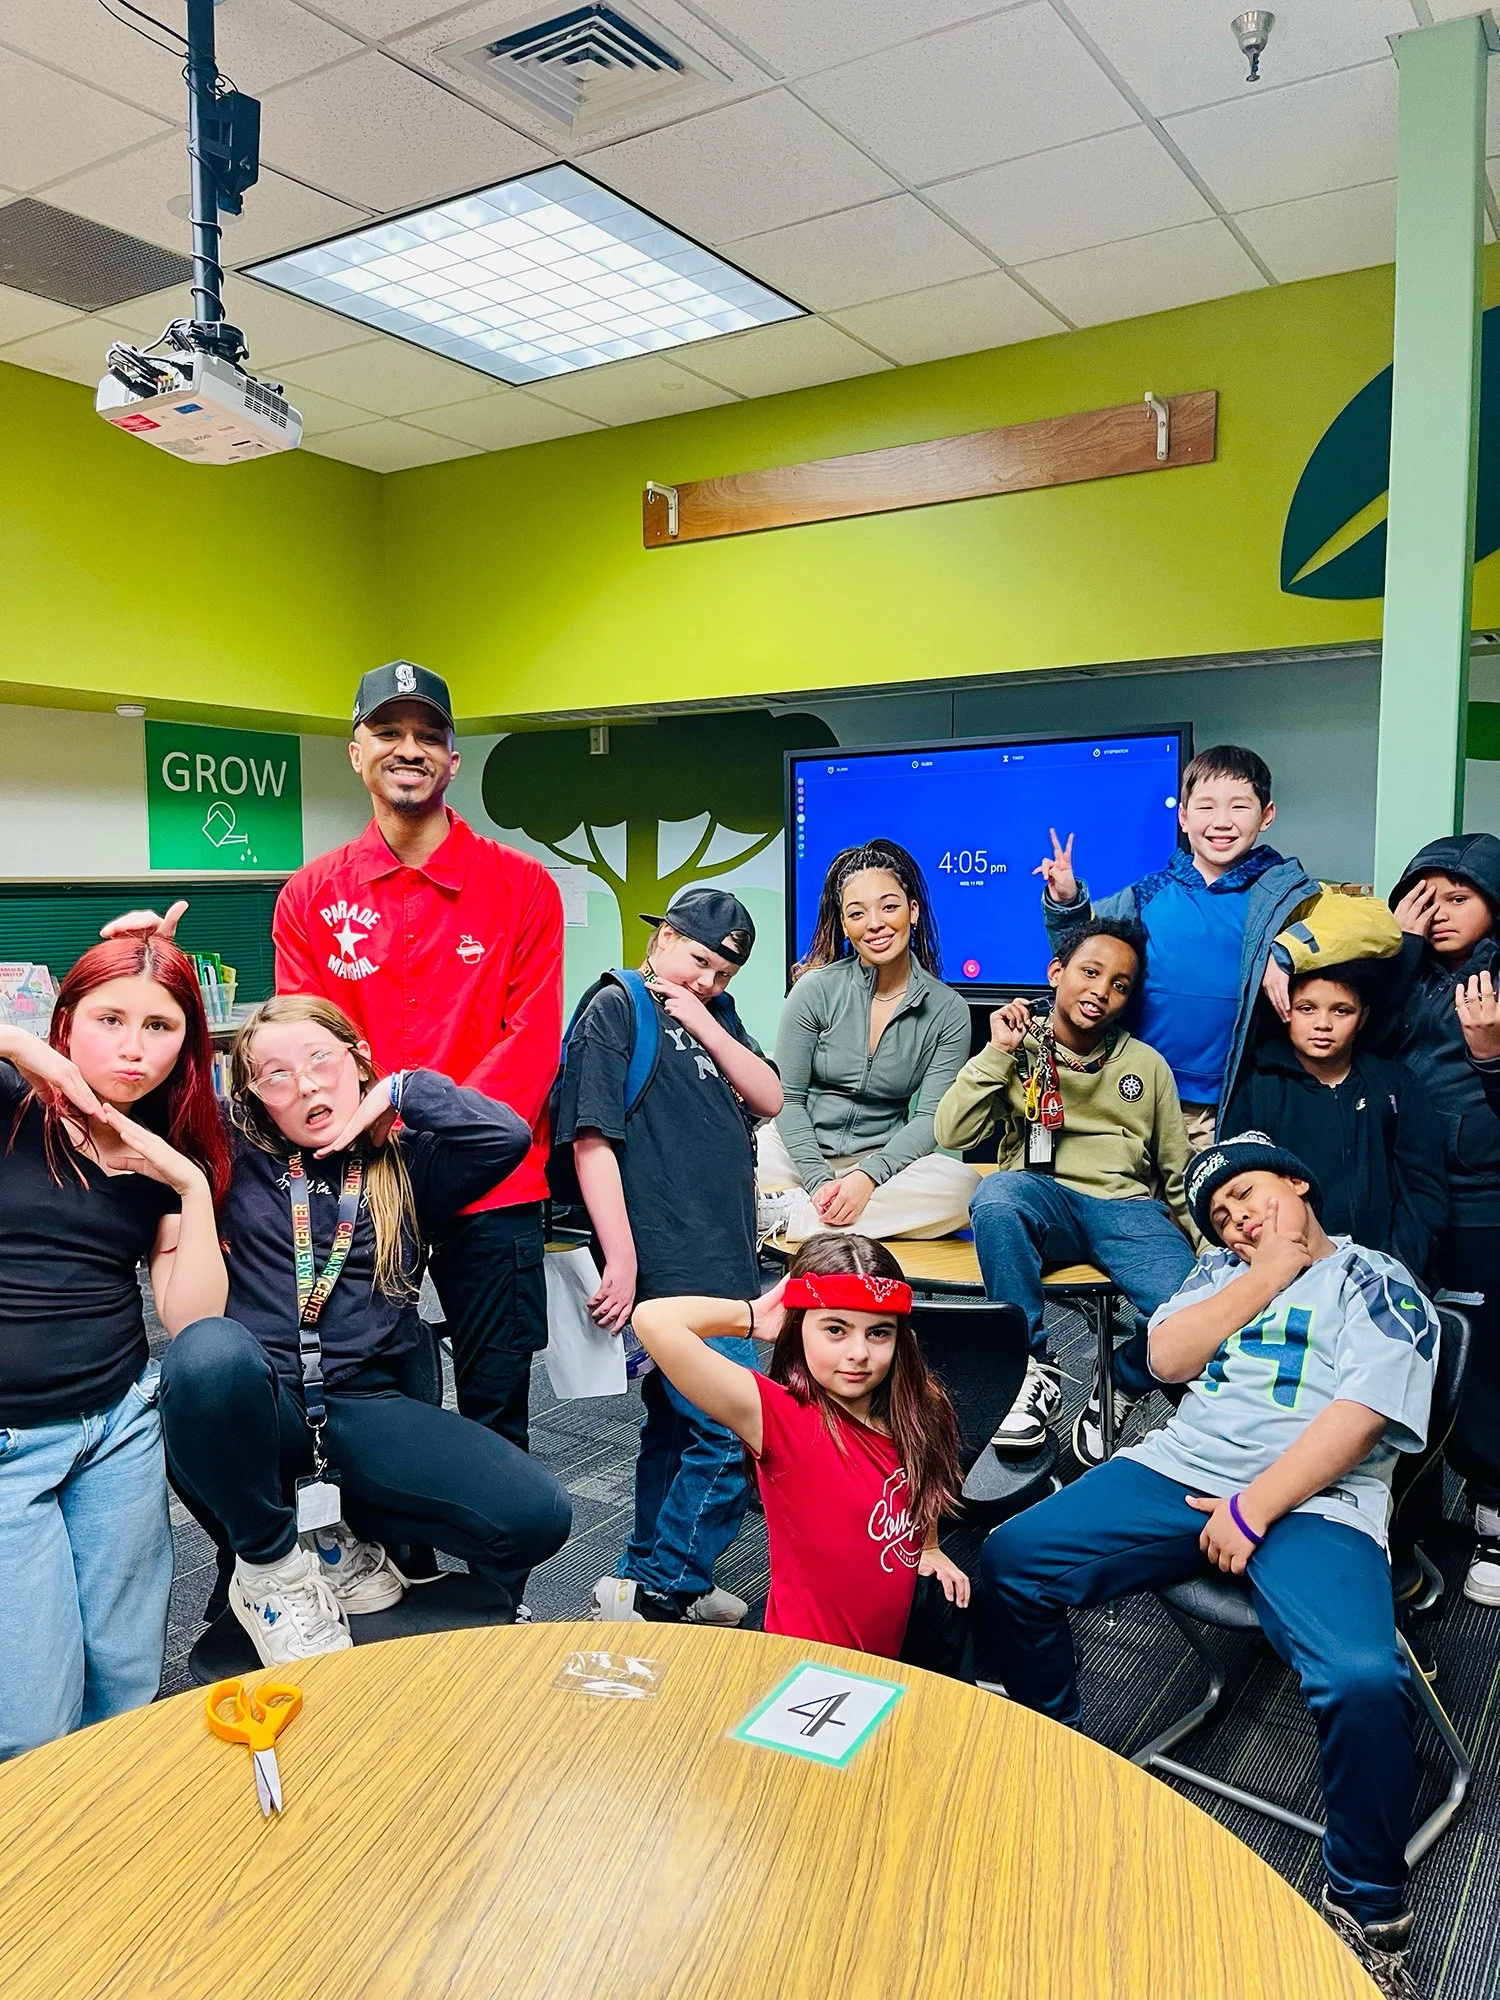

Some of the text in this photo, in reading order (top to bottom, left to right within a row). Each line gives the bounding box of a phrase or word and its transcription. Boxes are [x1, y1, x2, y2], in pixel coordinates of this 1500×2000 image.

[395, 664, 416, 693] S
[162, 751, 287, 797] GROW
[938, 850, 1007, 875] 4:05 pm
[320, 900, 381, 931] PARADE
[327, 953, 381, 981] MAHAL
[288, 1151, 305, 1179] CARL
[344, 1158, 363, 1197] CENTER
[293, 1203, 311, 1248] CENTER
[296, 1248, 314, 1290] MAXEY
[303, 1221, 353, 1323] CARL MAXEY CENTER
[787, 1691, 851, 1738] 4
